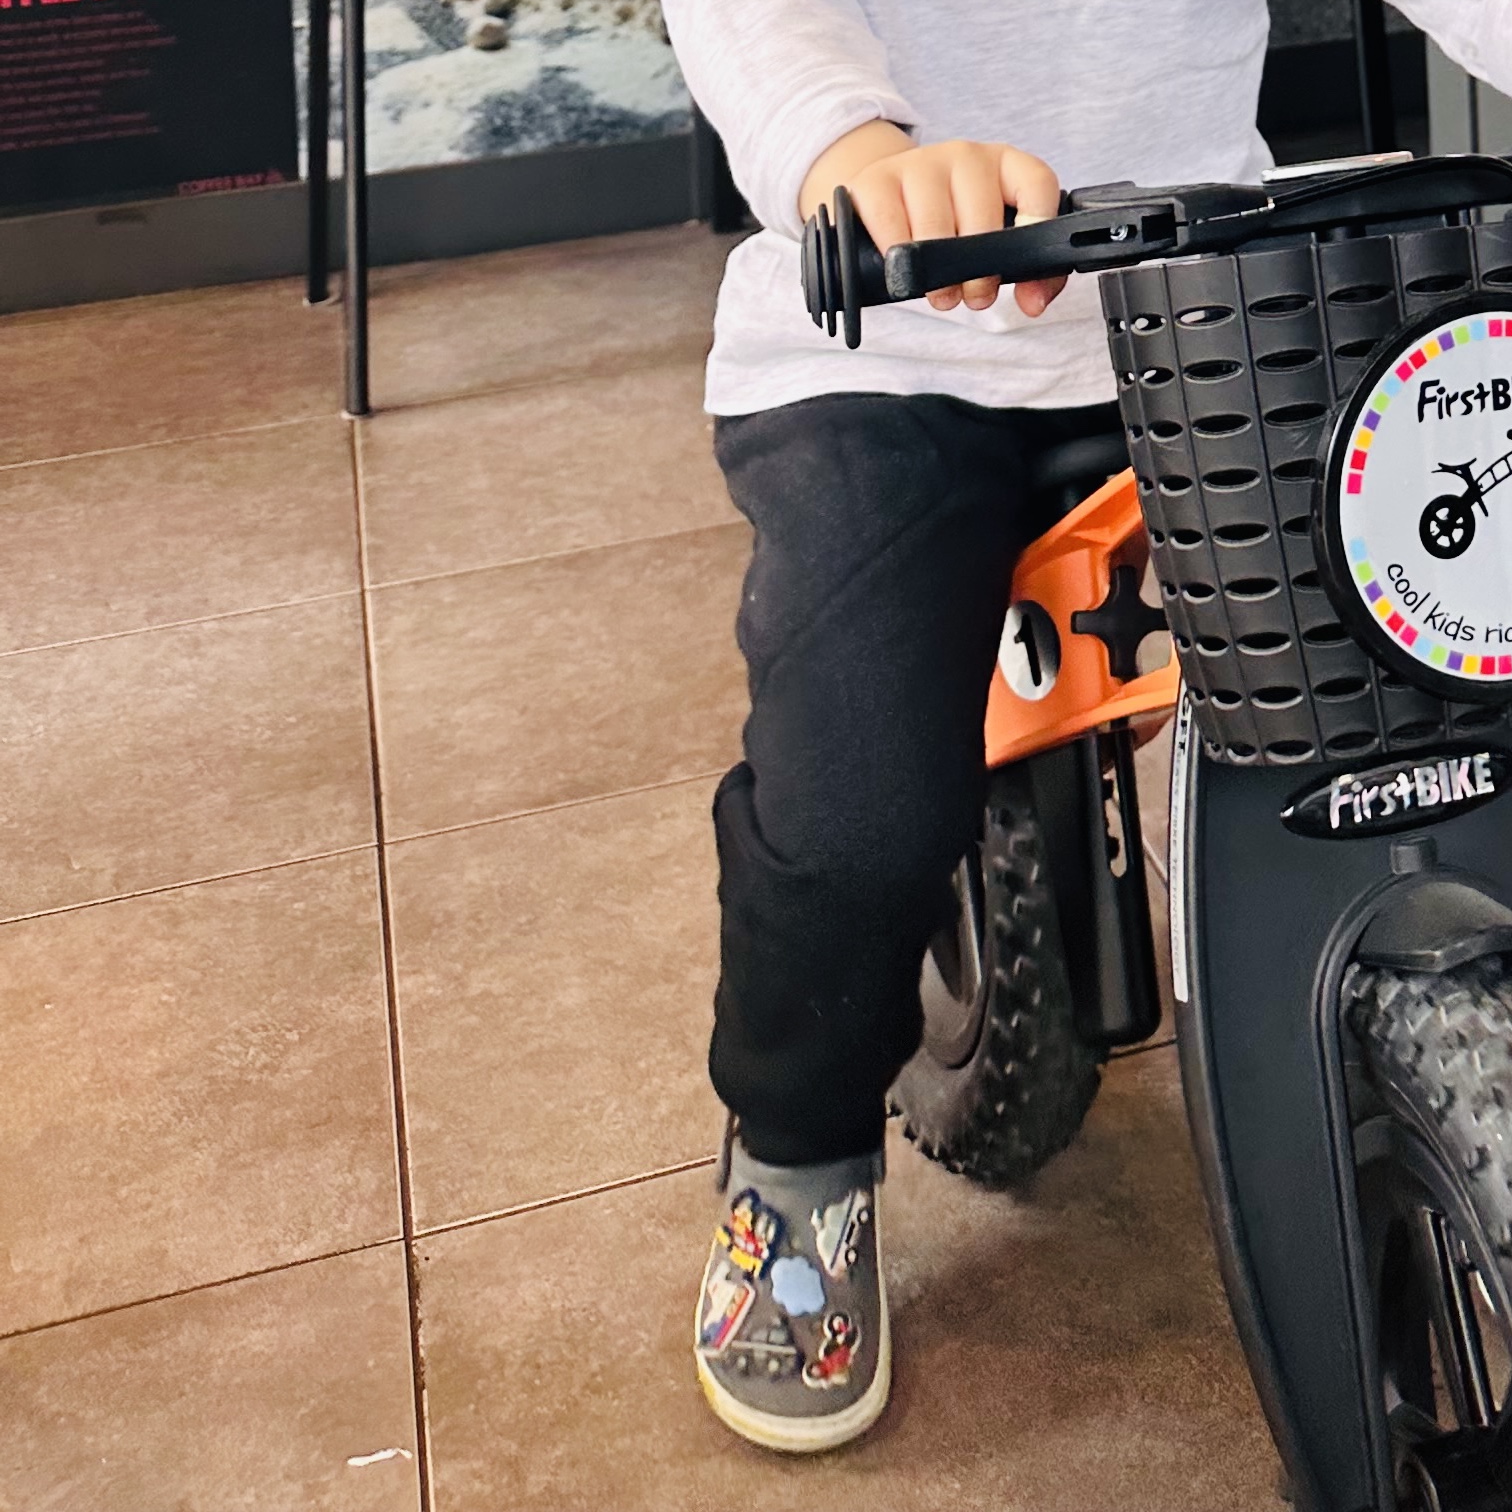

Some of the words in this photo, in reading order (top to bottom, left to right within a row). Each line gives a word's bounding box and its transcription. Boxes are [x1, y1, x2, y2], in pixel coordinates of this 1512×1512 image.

[1387, 563, 1430, 613] cool
[1423, 602, 1476, 643] kids
[1329, 752, 1495, 830] FirstBIKE
